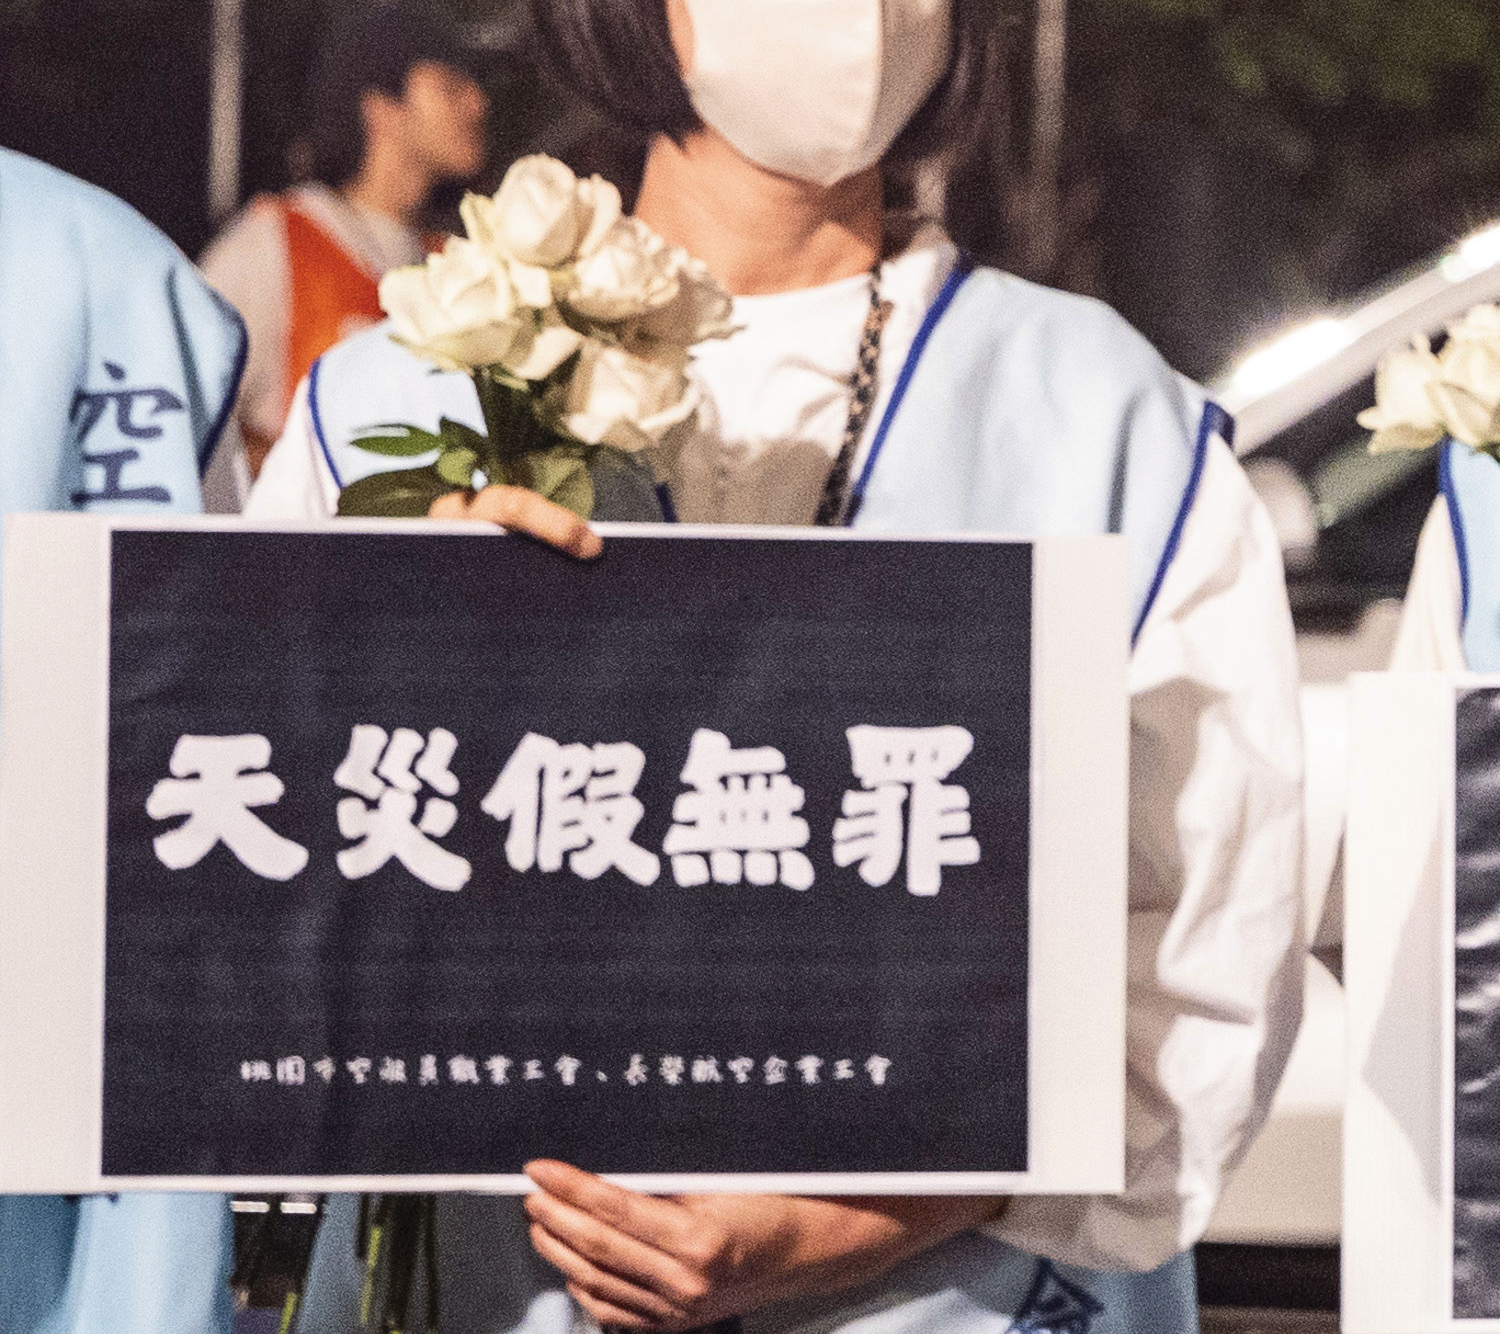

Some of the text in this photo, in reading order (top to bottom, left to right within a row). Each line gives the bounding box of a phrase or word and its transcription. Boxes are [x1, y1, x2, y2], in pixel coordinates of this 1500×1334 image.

[145, 723, 982, 897] 天災假無罪
